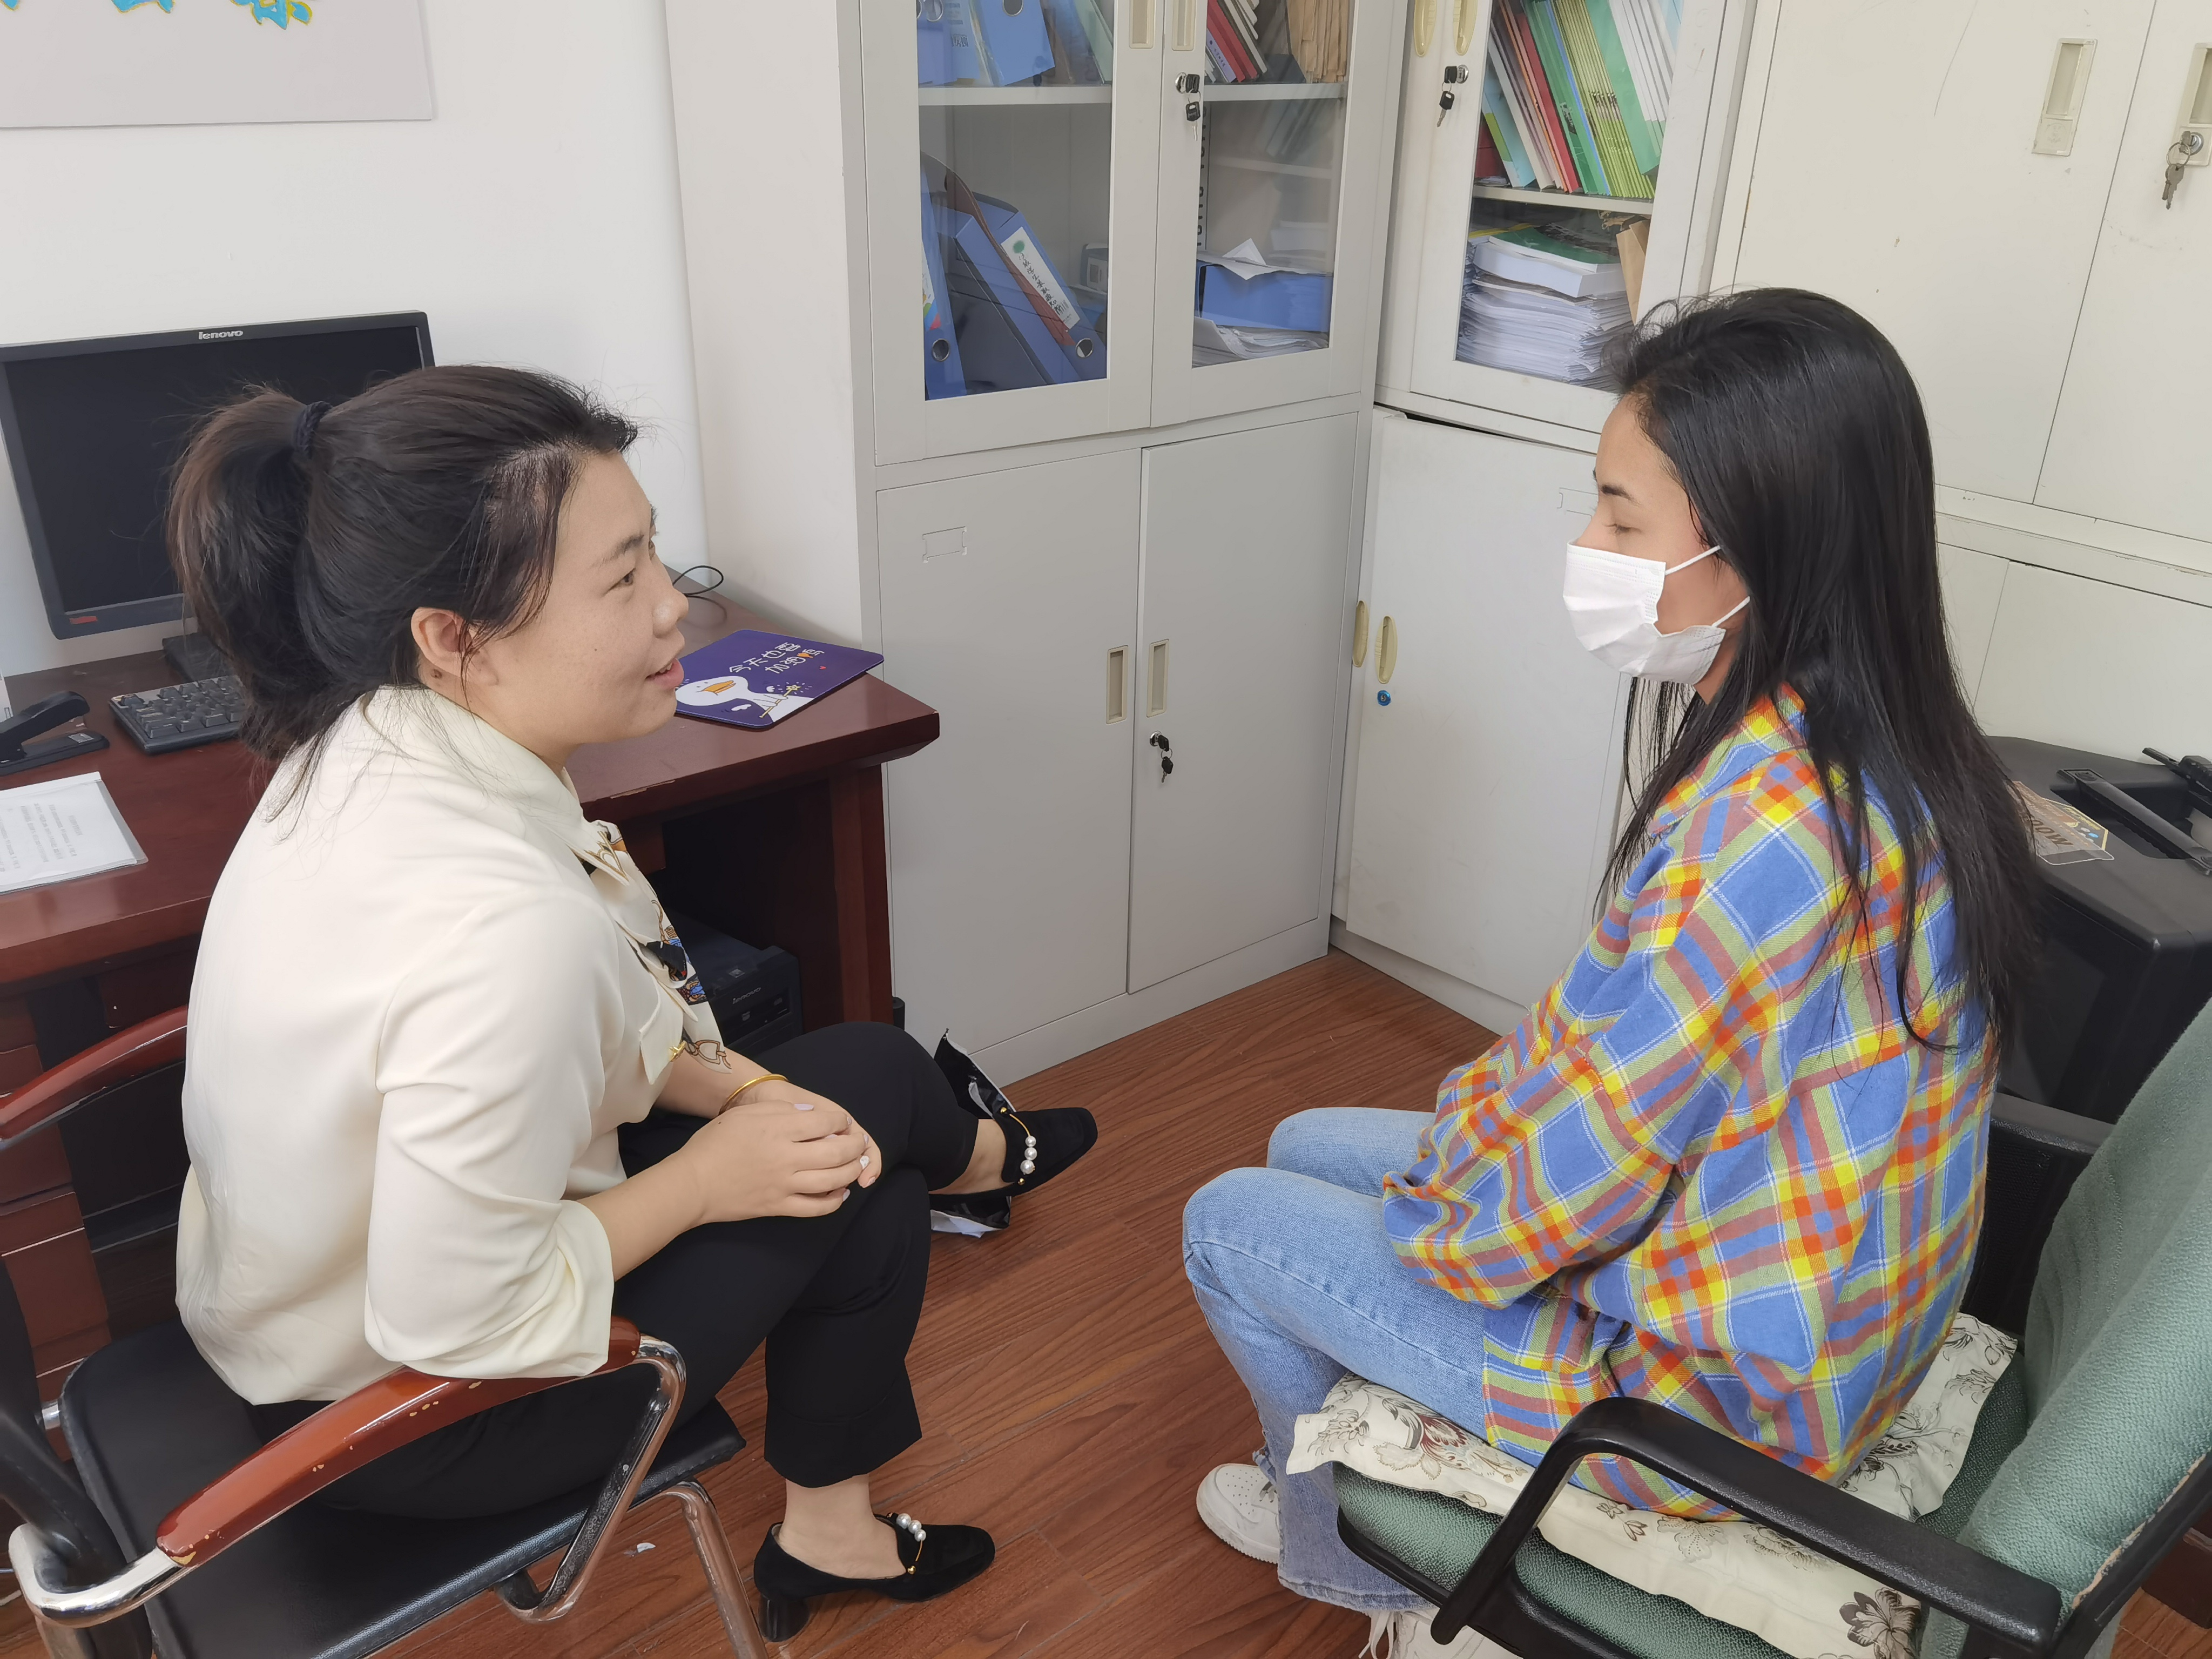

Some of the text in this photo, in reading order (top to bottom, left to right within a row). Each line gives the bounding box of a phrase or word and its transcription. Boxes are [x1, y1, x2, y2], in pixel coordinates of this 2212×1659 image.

[198, 330, 244, 340] lenovo
[729, 642, 801, 673] 今天也要
